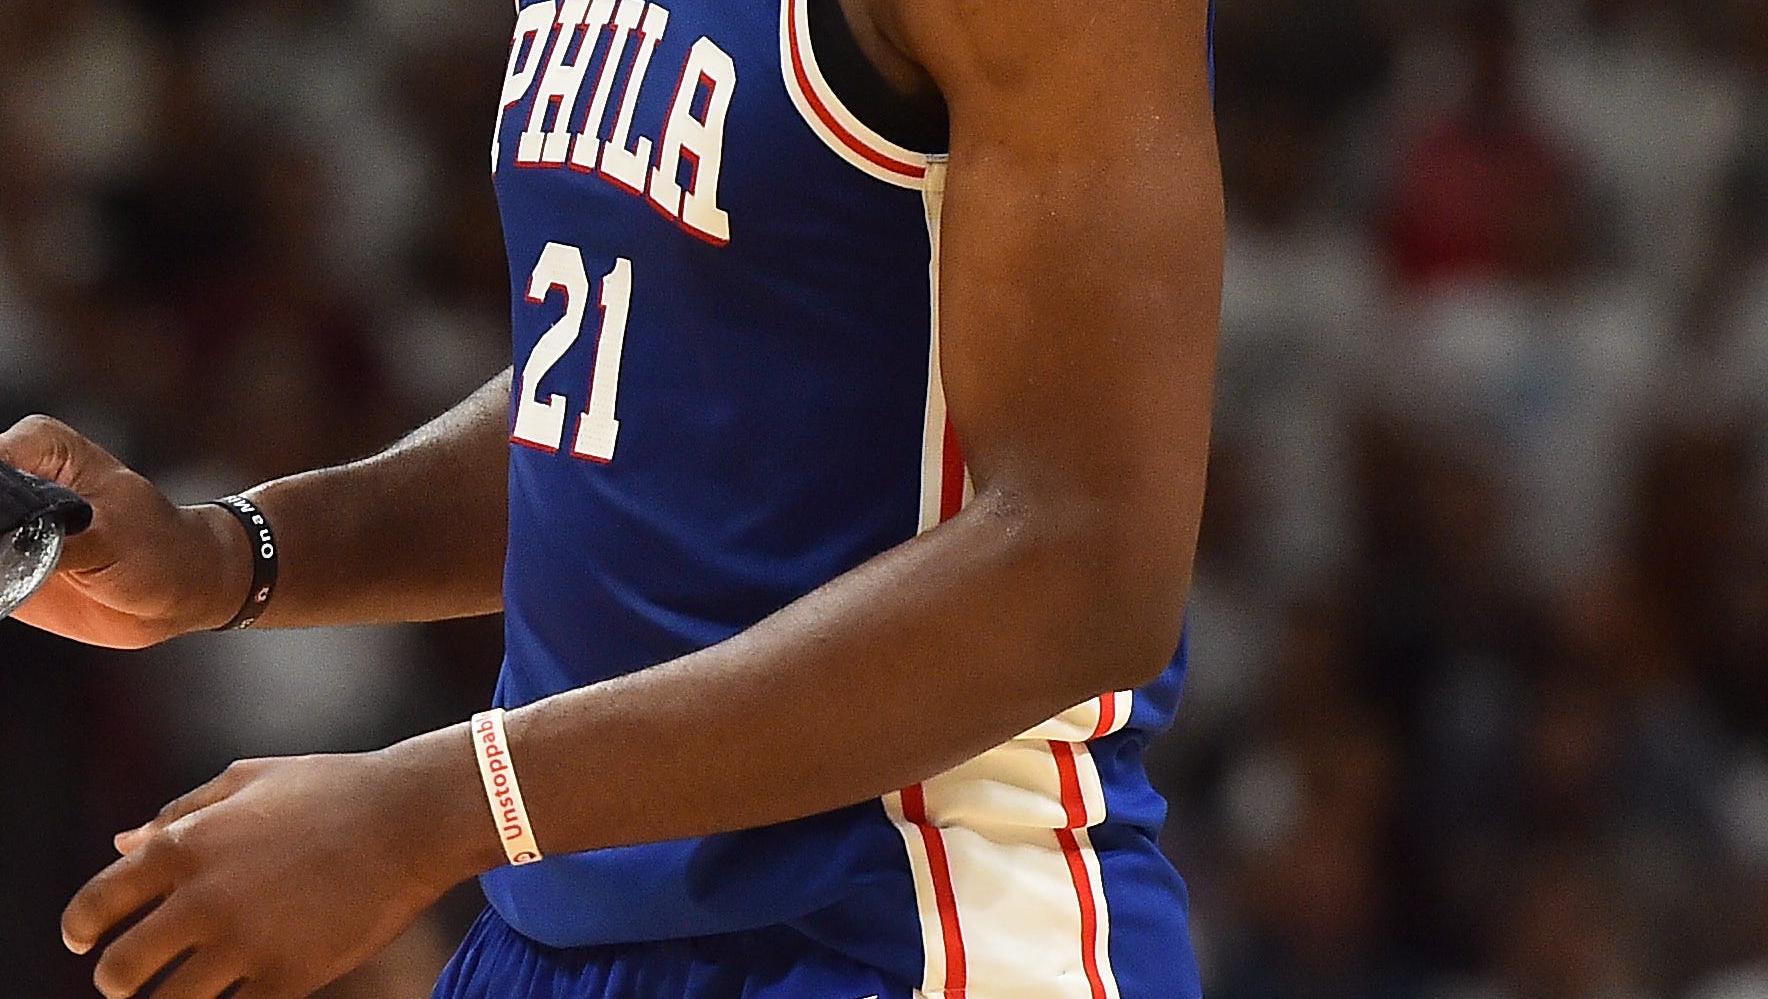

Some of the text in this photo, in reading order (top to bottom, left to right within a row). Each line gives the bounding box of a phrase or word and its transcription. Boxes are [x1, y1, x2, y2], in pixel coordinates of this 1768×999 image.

[510, 241, 632, 465] 21
[251, 513, 265, 526] a
[259, 527, 274, 559] On
